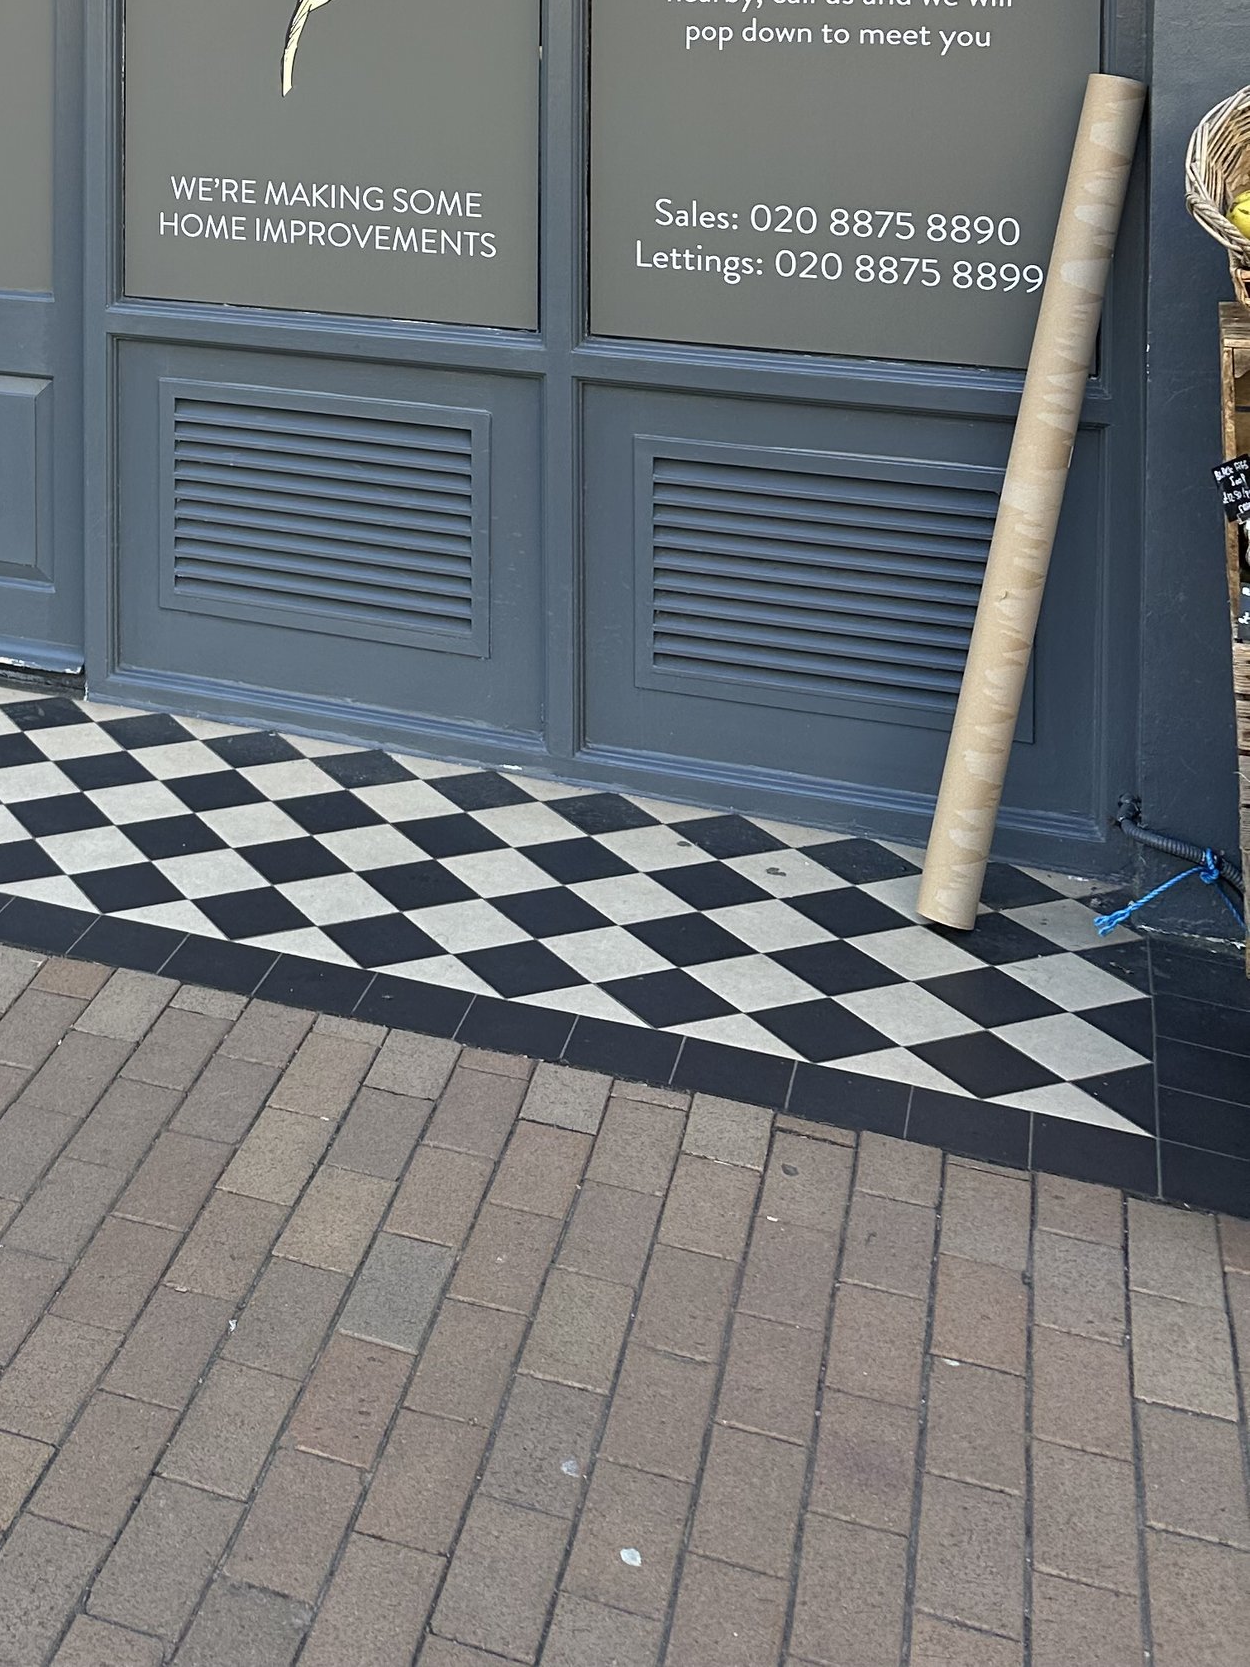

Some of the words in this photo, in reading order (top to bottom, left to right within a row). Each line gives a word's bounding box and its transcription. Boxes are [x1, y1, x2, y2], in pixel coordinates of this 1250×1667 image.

[686, 26, 733, 50] pop
[742, 18, 812, 43] down
[821, 24, 849, 44] to
[860, 26, 931, 45] meet
[939, 31, 990, 55] you
[265, 181, 383, 211] MAKING
[393, 188, 482, 217] SOME
[160, 212, 246, 240] HOME
[256, 218, 496, 257] IMPROVEMENTS
[655, 199, 738, 230] Sales:
[751, 205, 817, 234] 020
[830, 209, 915, 239] 8875
[927, 214, 1020, 245] 8890
[637, 240, 762, 284] Lettings:
[775, 250, 842, 280] 020
[855, 255, 940, 286] 8875
[953, 261, 1043, 293] 8899
